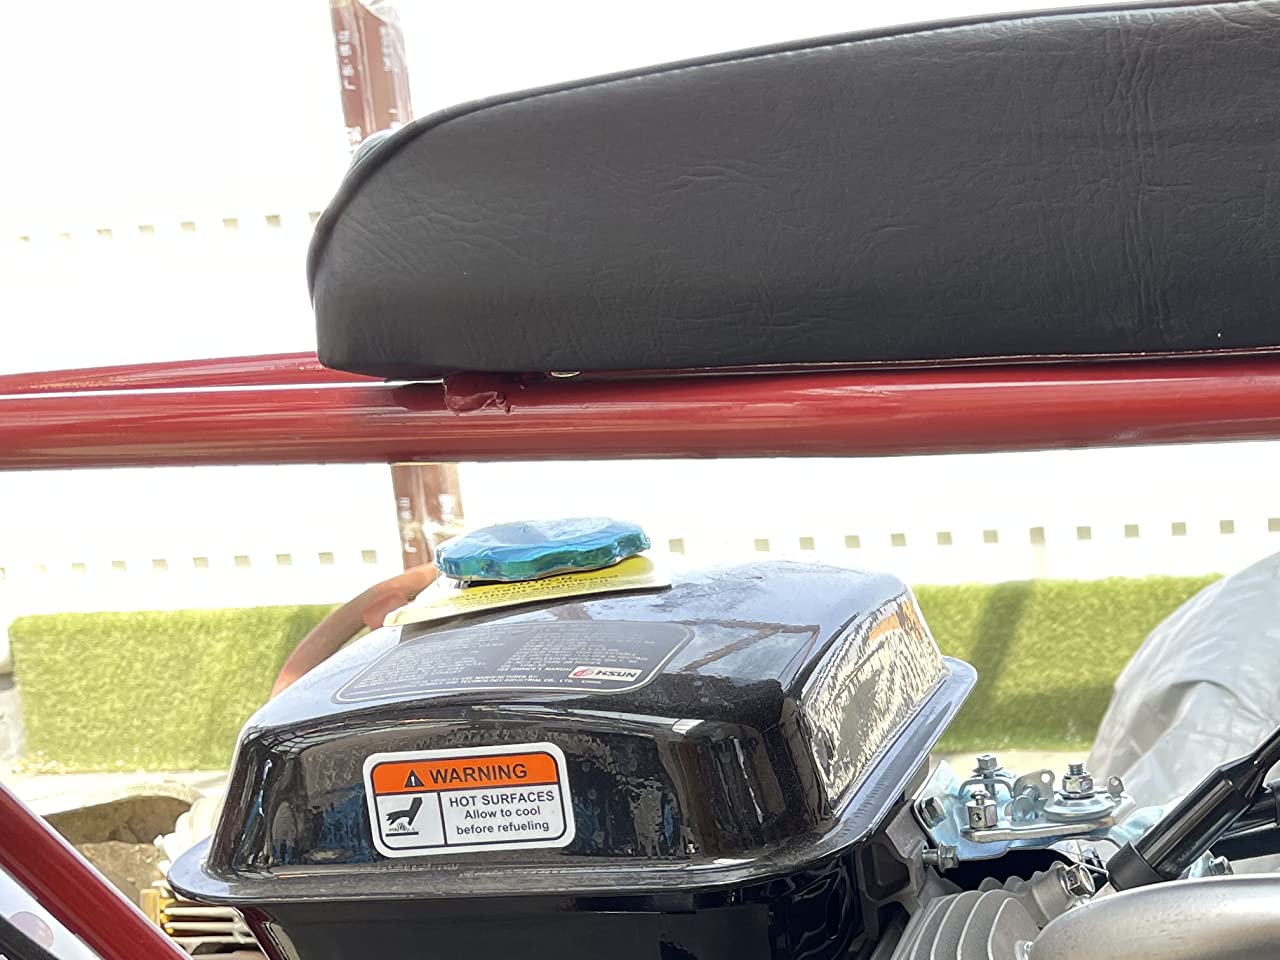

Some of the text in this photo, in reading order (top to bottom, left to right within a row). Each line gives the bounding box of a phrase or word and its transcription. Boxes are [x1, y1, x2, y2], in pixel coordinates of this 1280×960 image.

[428, 763, 528, 785] WARNING
[450, 791, 555, 808] HOT SURFACES
[464, 806, 541, 820] Allow to cool
[456, 820, 550, 835] before refueling
